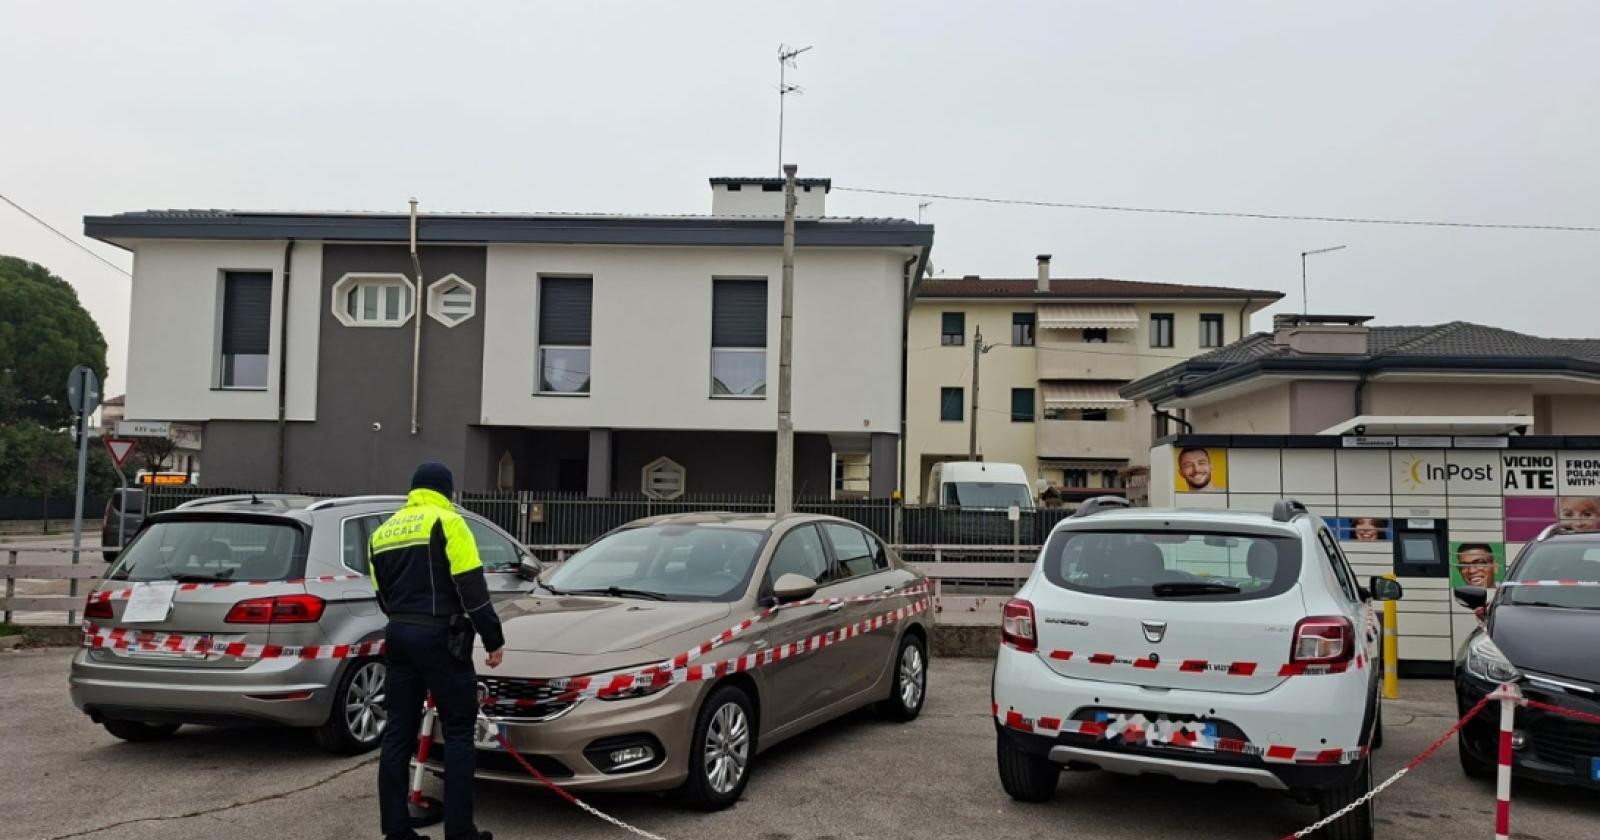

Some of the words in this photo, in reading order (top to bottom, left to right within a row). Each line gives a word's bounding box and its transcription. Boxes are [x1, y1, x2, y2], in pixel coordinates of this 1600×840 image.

[1503, 456, 1554, 467] VICINO
[1426, 463, 1494, 481] InPost
[1504, 470, 1519, 489] A
[1521, 470, 1554, 489] TE
[378, 524, 422, 540] LOCALE
